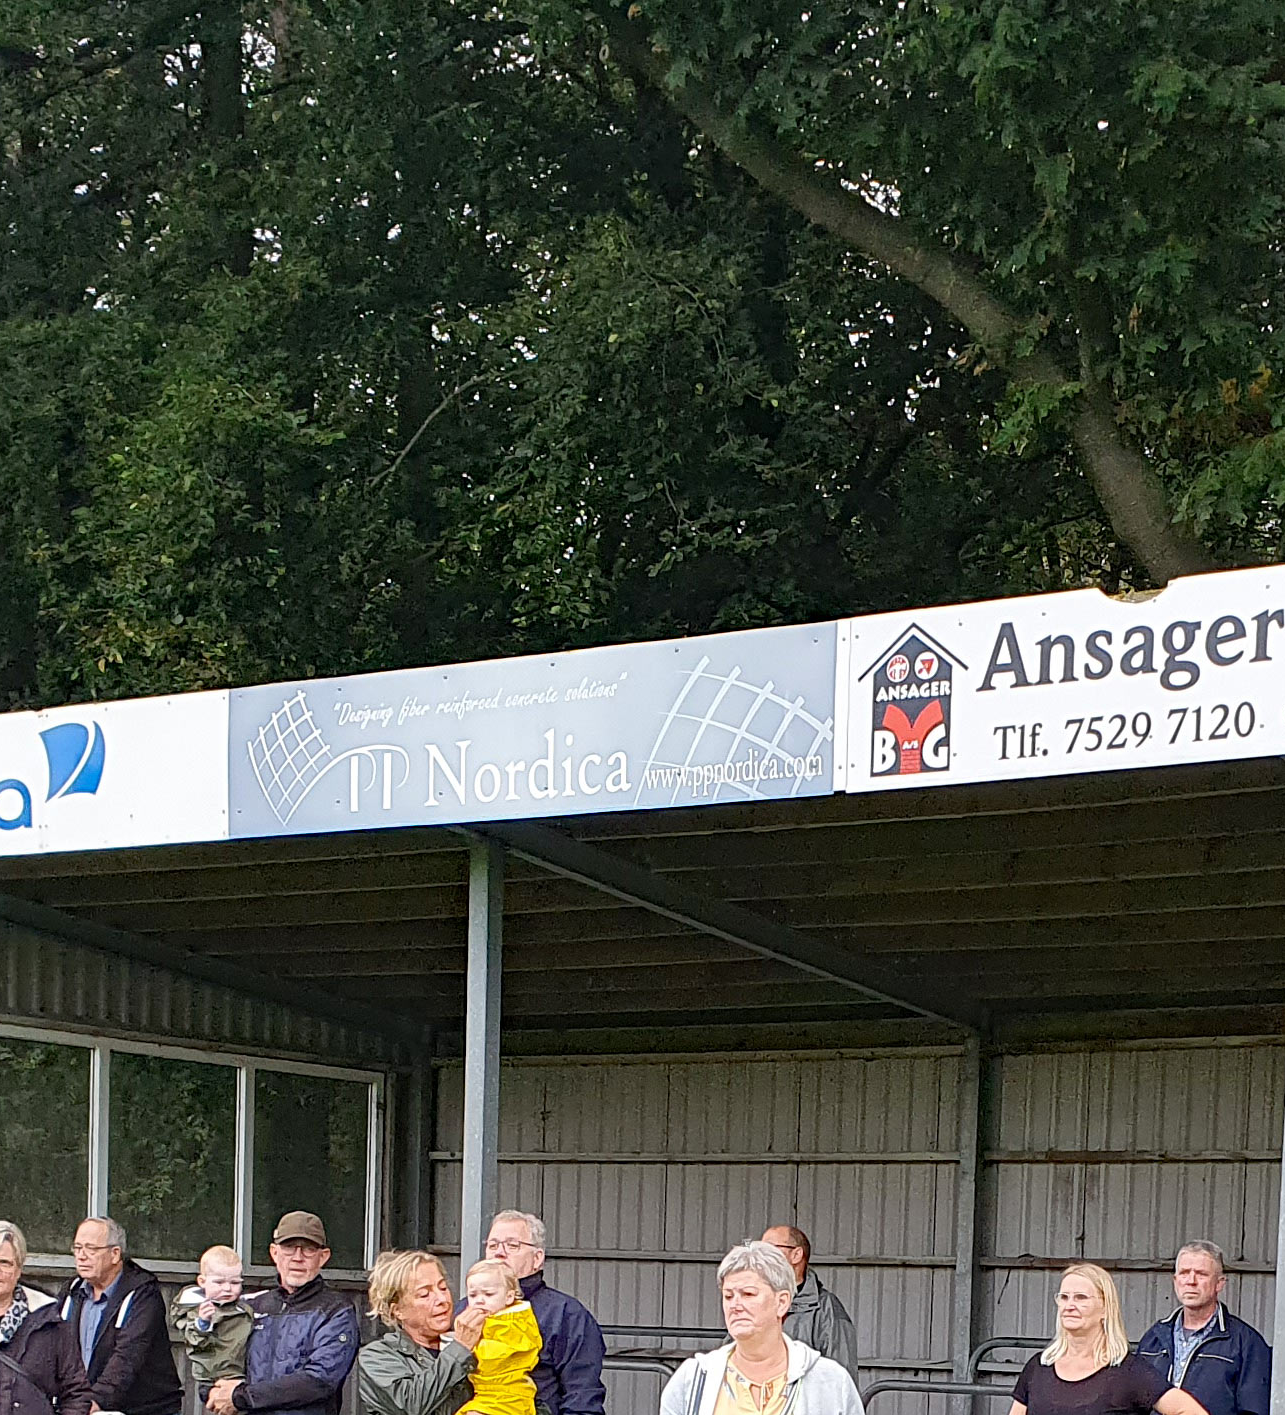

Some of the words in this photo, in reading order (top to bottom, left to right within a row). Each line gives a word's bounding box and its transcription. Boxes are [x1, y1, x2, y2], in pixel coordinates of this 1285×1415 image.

[976, 605, 1285, 692] Ansager
[397, 696, 430, 726] fiber
[435, 690, 498, 720] reinforced
[504, 686, 559, 708] concrete
[876, 681, 951, 702] ANSAGER
[994, 724, 1048, 761] Tlf.
[1064, 713, 1151, 755] 7529
[1167, 703, 1255, 742] 7120
[423, 728, 632, 807] Nordica
[644, 748, 823, 798] www.ppnordica.com
